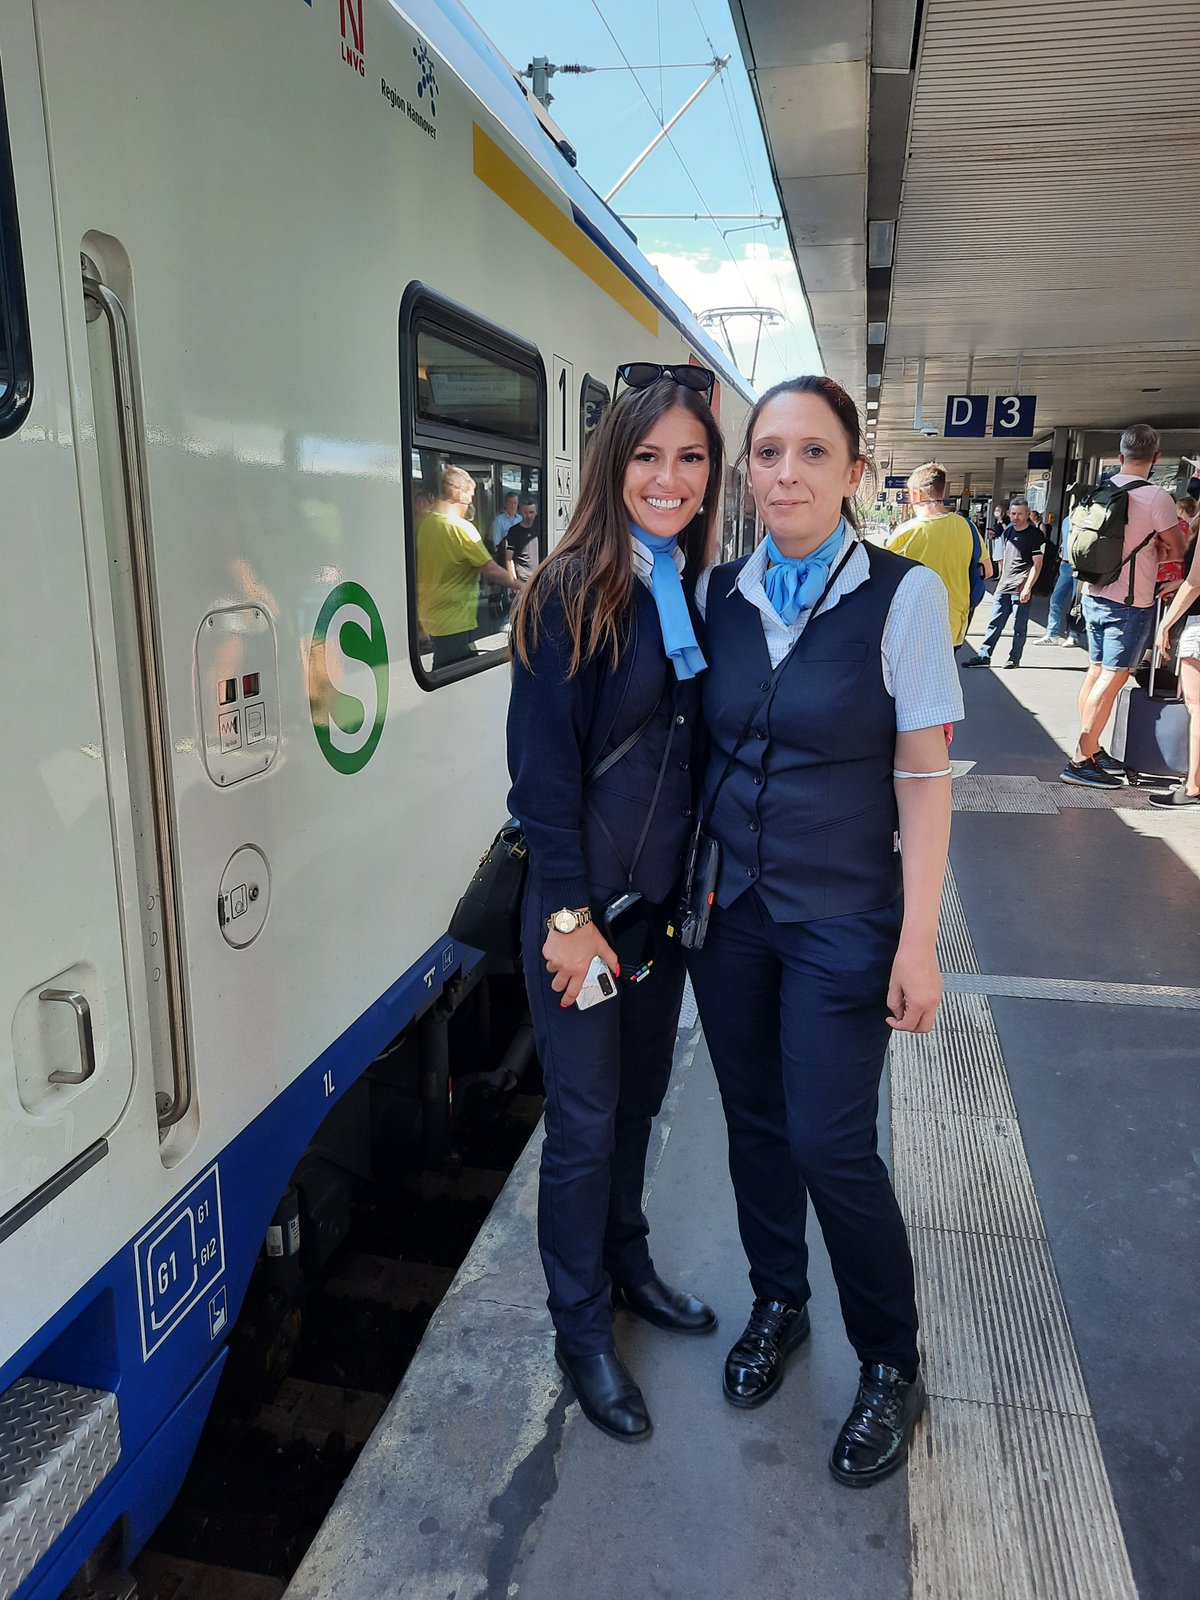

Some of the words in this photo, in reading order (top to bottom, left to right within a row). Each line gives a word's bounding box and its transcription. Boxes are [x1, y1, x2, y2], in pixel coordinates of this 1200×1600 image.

[341, 41, 365, 77] LNVG
[381, 77, 406, 113] Region
[406, 101, 437, 140] Hannover
[558, 367, 567, 452] 1
[951, 397, 973, 426] D
[999, 396, 1021, 428] 3
[325, 603, 378, 754] S
[323, 1069, 335, 1098] 1L
[197, 1199, 209, 1224] G1
[157, 1250, 177, 1295] G1
